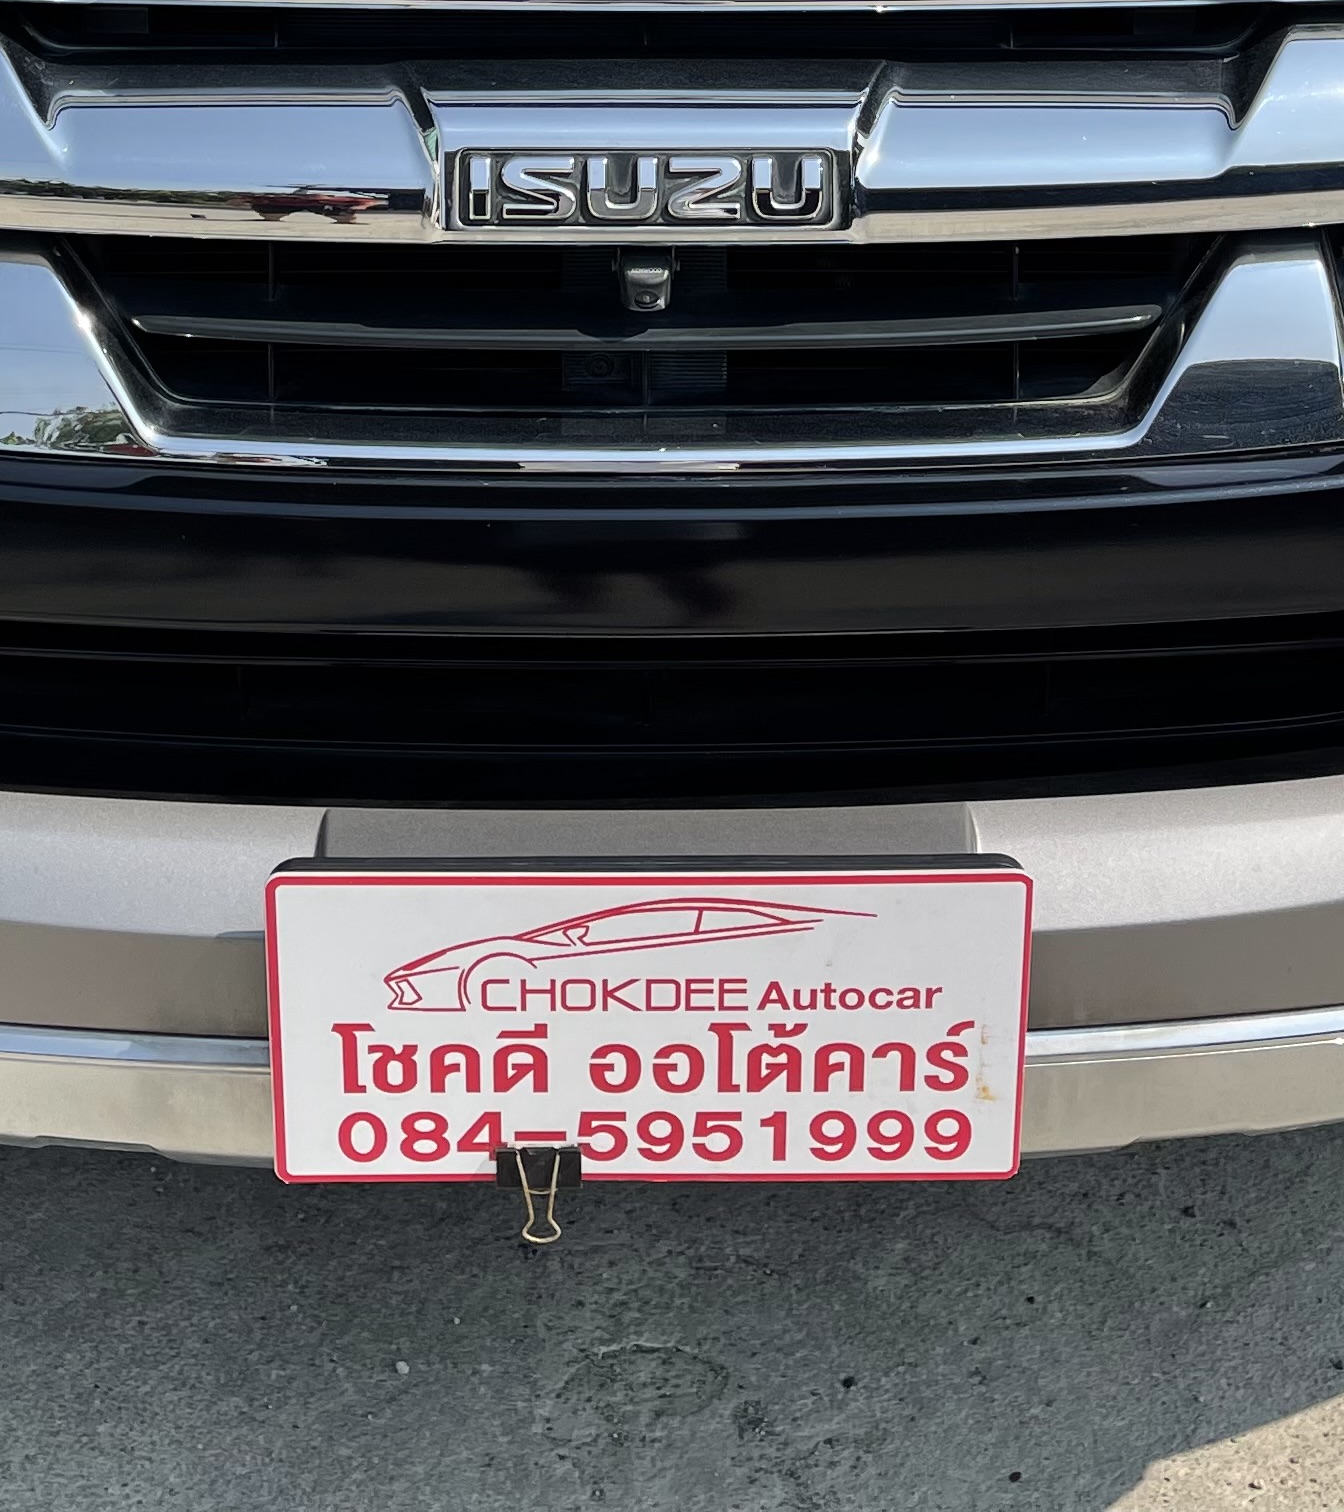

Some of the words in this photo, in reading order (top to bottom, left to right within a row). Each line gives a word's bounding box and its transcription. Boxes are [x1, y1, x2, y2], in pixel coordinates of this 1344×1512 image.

[468, 155, 824, 221] ISUZU
[481, 978, 748, 1012] CHOKDEE
[758, 981, 942, 1011] Autocar
[331, 1021, 549, 1095] โชคดี
[588, 1019, 976, 1094] ออโต้คาร์
[338, 1109, 973, 1163] 084-5951999
